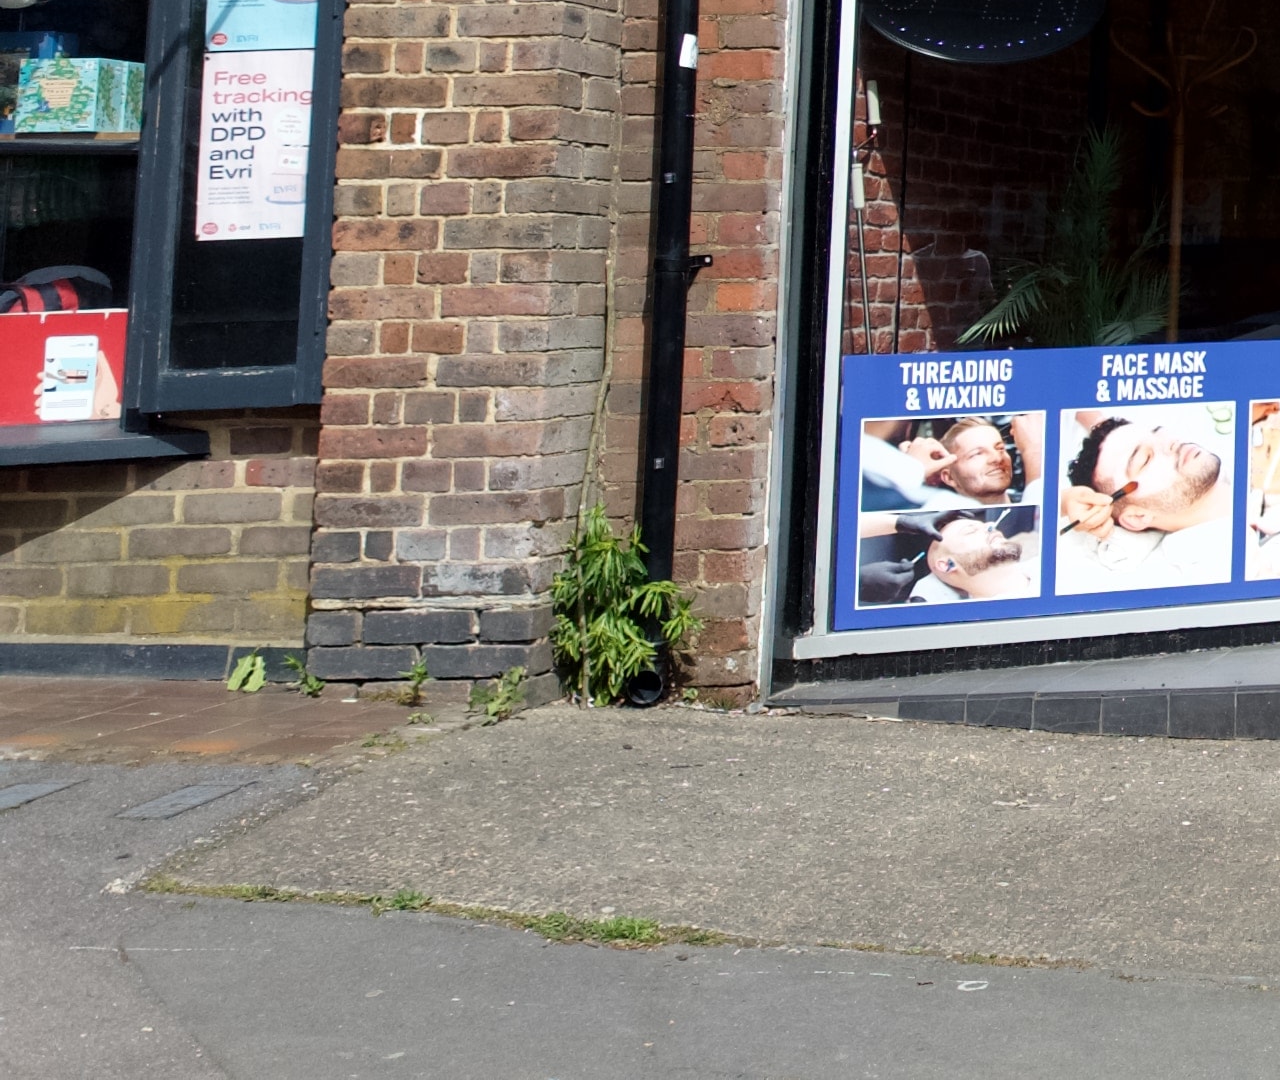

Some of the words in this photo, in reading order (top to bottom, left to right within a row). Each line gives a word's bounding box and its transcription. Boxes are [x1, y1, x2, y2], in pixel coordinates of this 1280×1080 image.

[213, 71, 267, 86] Free
[212, 88, 313, 106] tracking
[211, 107, 262, 123] with
[211, 126, 266, 143] DPD
[209, 145, 255, 161] and
[209, 164, 253, 180] Evri
[899, 357, 1013, 386] THREADING
[1102, 353, 1149, 378] FACE
[1153, 350, 1207, 375] MASK
[1096, 378, 1112, 402] &
[1115, 375, 1205, 402] MASSAGE
[905, 388, 922, 411] &
[926, 384, 1007, 410] WAXING
